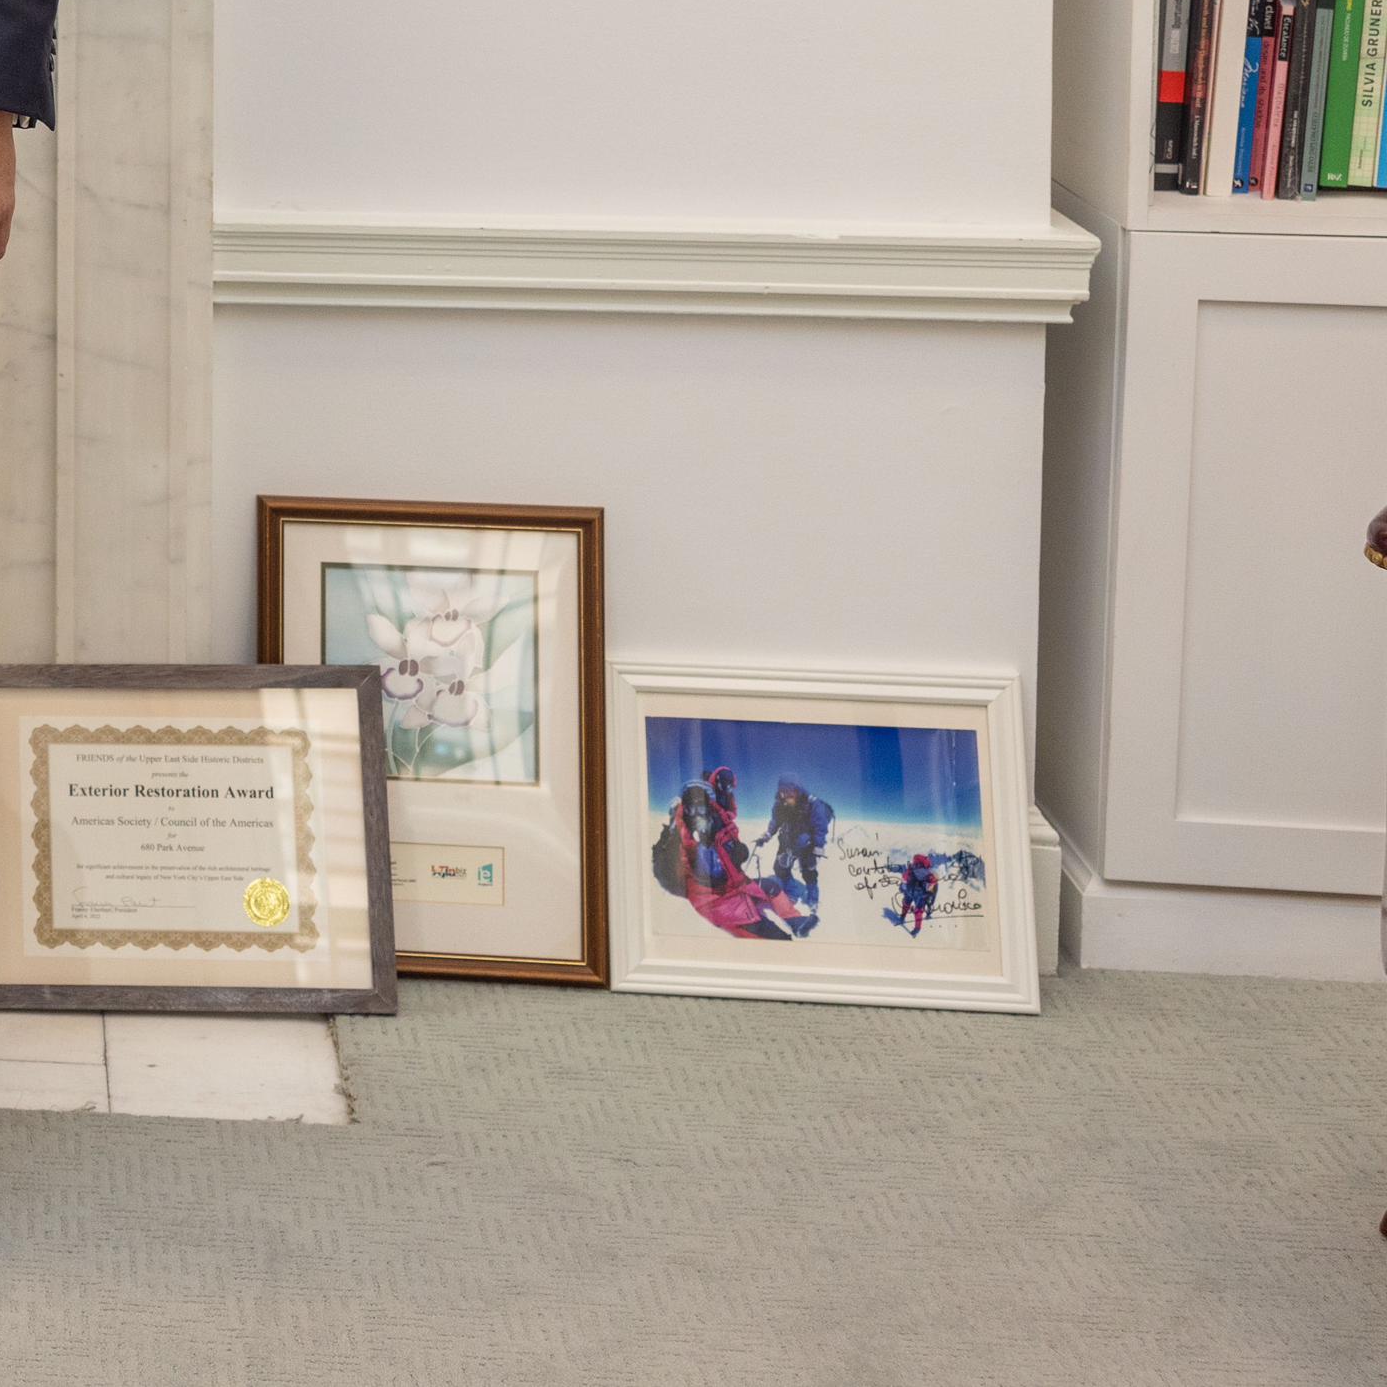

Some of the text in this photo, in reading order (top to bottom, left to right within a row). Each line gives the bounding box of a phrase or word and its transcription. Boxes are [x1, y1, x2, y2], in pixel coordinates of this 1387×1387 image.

[1263, 4, 1273, 31] clavel
[1362, 0, 1383, 108] SILVIA GRUNER
[76, 754, 115, 763] FRIENDS
[126, 754, 138, 763] the
[139, 754, 162, 764] Upper
[164, 755, 181, 764] East
[183, 755, 199, 764] Side
[201, 755, 230, 764] Historic
[232, 755, 264, 765] Districts
[68, 783, 275, 800] Exterior Restoration Award
[71, 816, 115, 827] Americas
[117, 816, 152, 828] Society
[160, 816, 197, 828] Council
[200, 816, 210, 828] of
[212, 817, 227, 828] the
[229, 818, 274, 829] Americas
[140, 843, 205, 853] 680 Park Avenue
